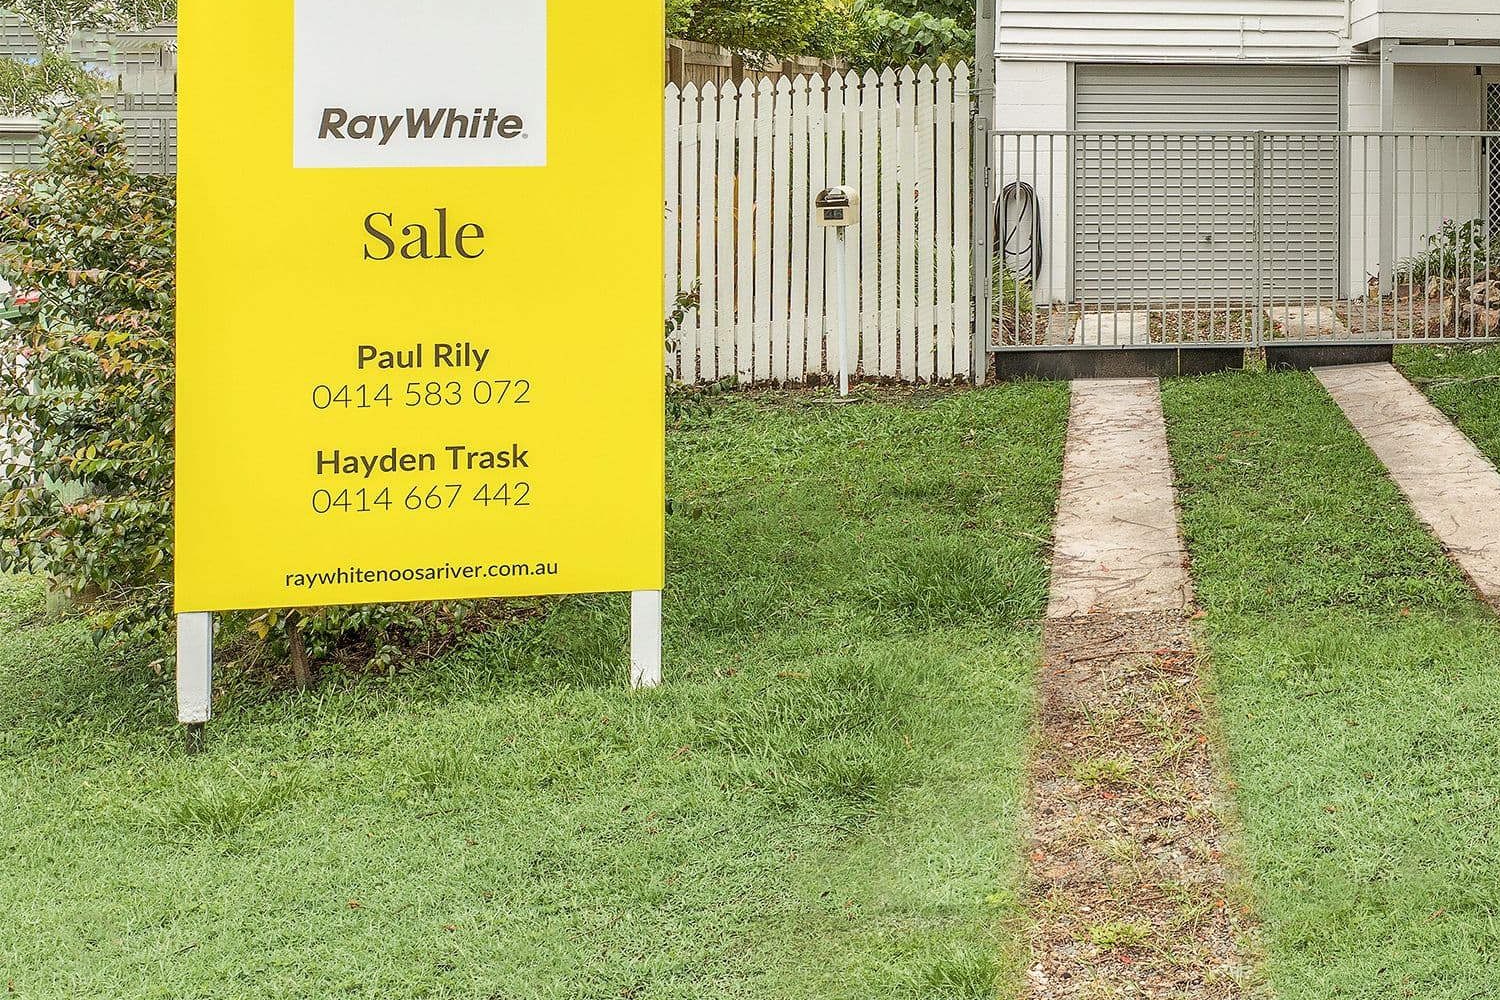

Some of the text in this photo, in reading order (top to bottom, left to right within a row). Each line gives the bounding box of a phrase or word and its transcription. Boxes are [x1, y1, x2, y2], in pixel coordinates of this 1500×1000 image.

[364, 208, 484, 260] Sale
[358, 342, 489, 371] Paul Rily
[313, 380, 530, 409] 0414 583 072
[317, 443, 529, 478] Hayden Trask
[313, 481, 530, 513] 0414 667 442
[286, 563, 557, 587] raywhitenoosariver.com.au
